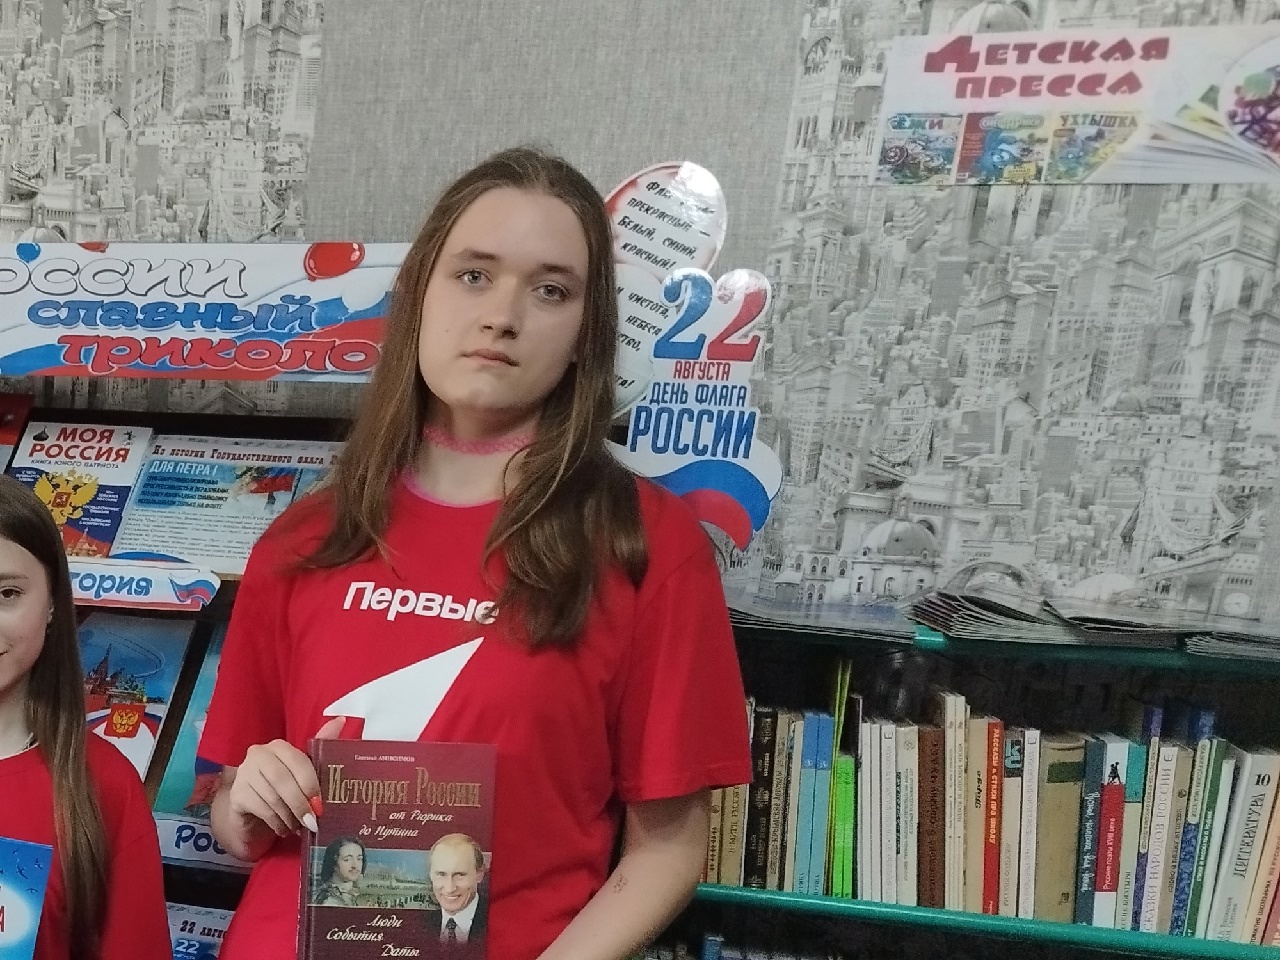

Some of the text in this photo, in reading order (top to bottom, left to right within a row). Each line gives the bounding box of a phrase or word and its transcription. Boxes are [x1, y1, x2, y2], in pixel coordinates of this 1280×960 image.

[955, 71, 1142, 99] ПРЕССА
[1060, 114, 1138, 128] УХТЫШКА
[654, 269, 771, 362] 22
[58, 334, 384, 375] триколо
[673, 361, 731, 381] АВГУСТА
[649, 383, 748, 407] ДЕНЬ ФЛАГА
[56, 427, 115, 445] МОЯ
[630, 406, 757, 460] РОССИИ
[28, 443, 130, 463] РОССИЯ
[149, 461, 175, 473] ДЛЯ
[176, 463, 210, 475] ПЕТРА
[342, 581, 499, 625] Первые
[991, 729, 999, 766] РАССКАЗЫ
[1255, 774, 1271, 785] 10
[326, 764, 481, 820] История России
[1156, 768, 1172, 818] РОССИИ
[389, 810, 454, 825] от Рюрика
[359, 824, 420, 840] до Путина
[1233, 793, 1265, 878] ЛИТЕРАТУРА
[1149, 823, 1165, 880] НАРОДОВ
[1144, 885, 1157, 931] СКАЗКИ
[326, 925, 384, 941] События
[367, 914, 403, 928] Люди
[175, 939, 200, 955] 22
